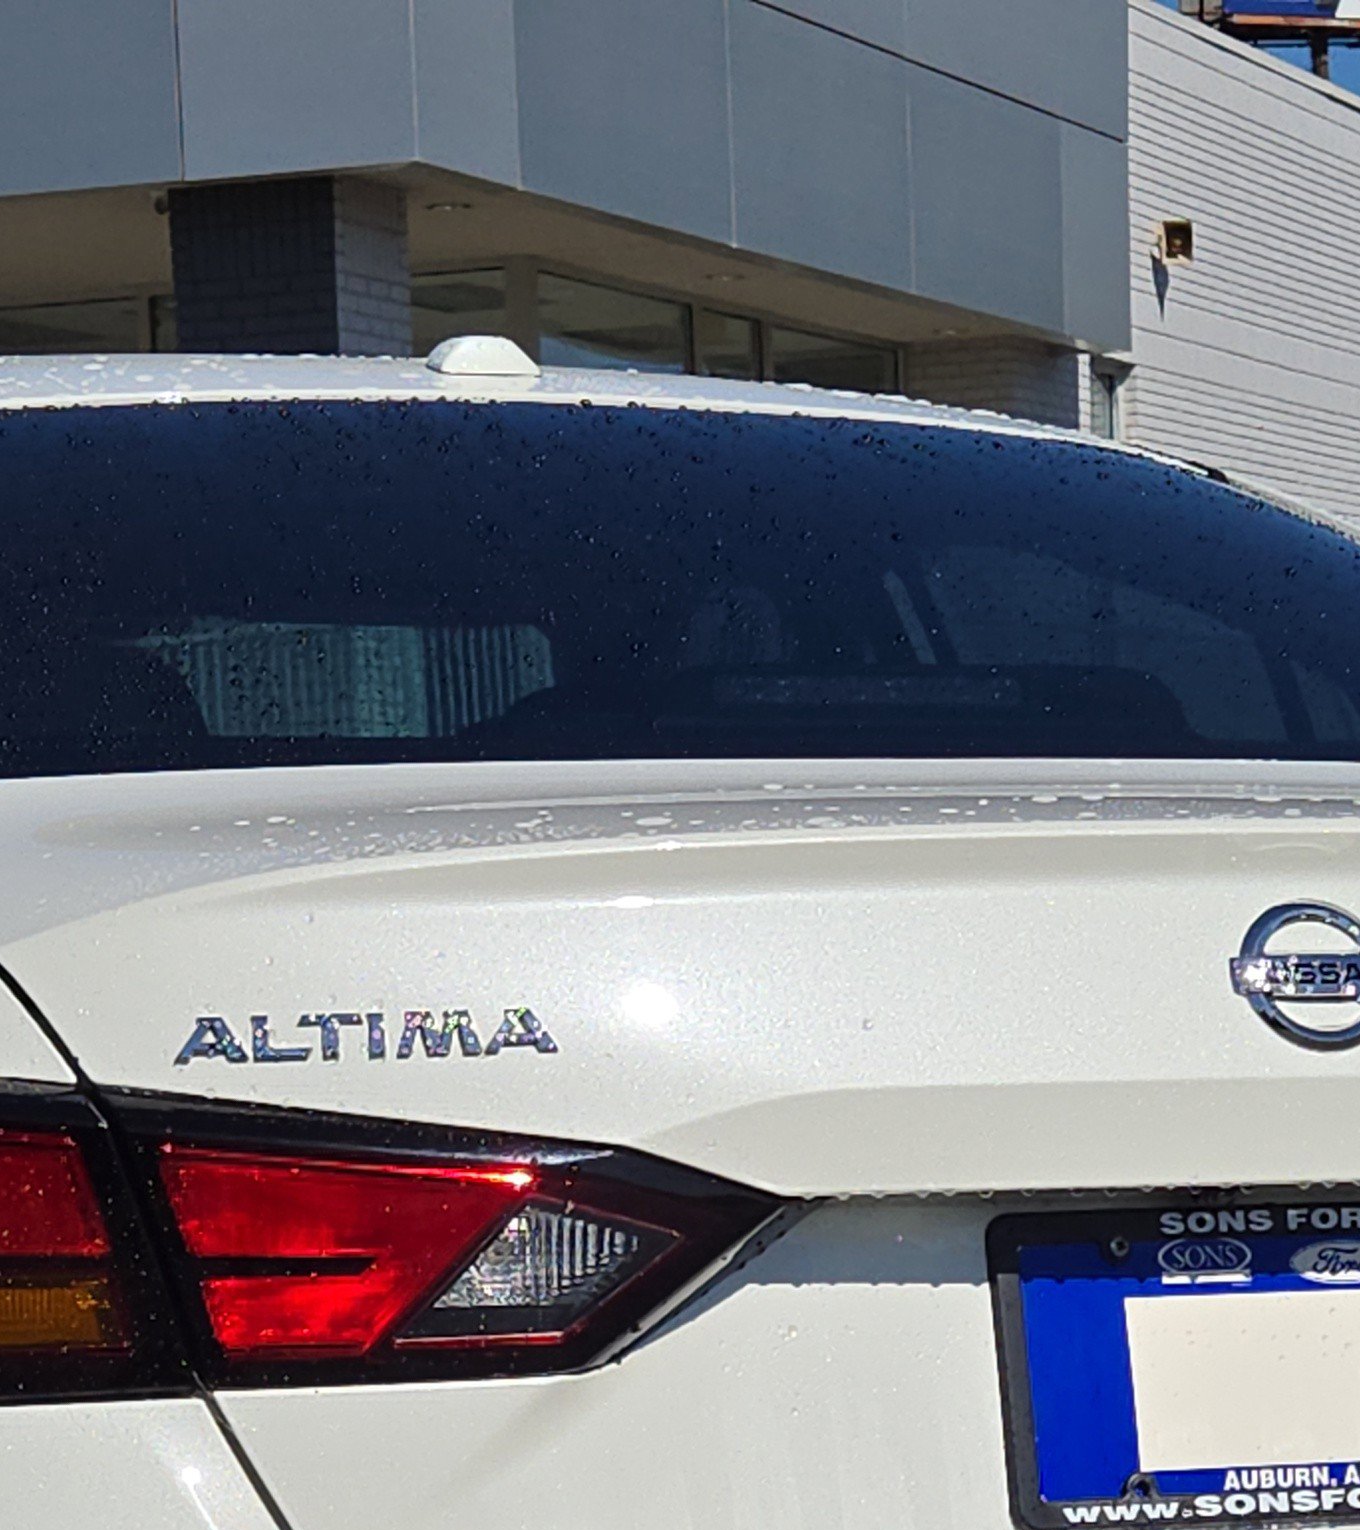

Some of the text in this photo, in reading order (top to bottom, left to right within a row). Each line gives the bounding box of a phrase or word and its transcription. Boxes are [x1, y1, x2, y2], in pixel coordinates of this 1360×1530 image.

[173, 1007, 559, 1067] ALTIMA
[1160, 1209, 1274, 1236] SONS
[1171, 1245, 1239, 1269] SONS
